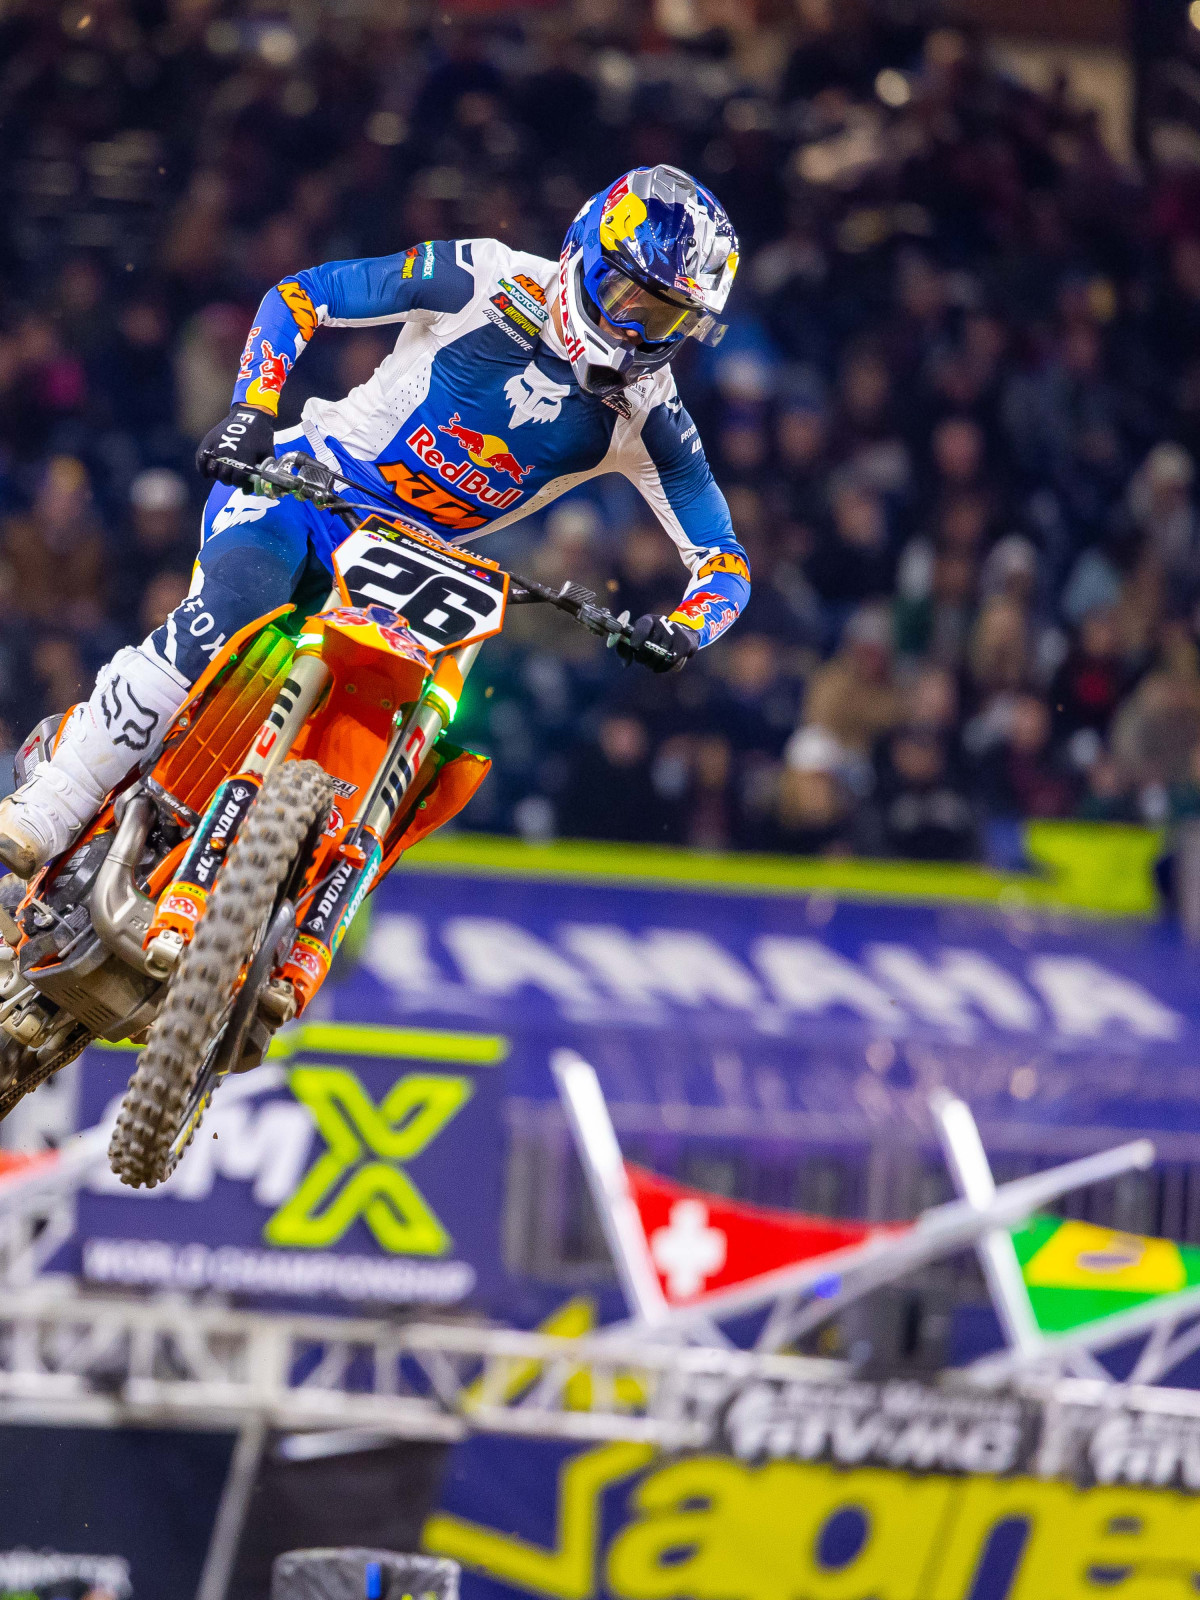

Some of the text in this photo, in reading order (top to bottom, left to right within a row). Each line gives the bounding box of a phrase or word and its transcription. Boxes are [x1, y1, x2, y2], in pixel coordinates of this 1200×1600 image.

[277, 282, 318, 341] KTM
[509, 287, 548, 321] MOTOREX
[512, 274, 547, 306] KTM
[482, 309, 533, 351] PROGRESSIVE
[218, 413, 255, 451] FOX
[406, 424, 524, 509] Red Bull
[374, 460, 492, 529] KTM
[400, 538, 467, 570] SUPERCROSS
[698, 553, 751, 583] KTM
[343, 547, 498, 648] 26
[196, 801, 241, 883] DUNOP
[343, 856, 380, 929] MOTOREX
